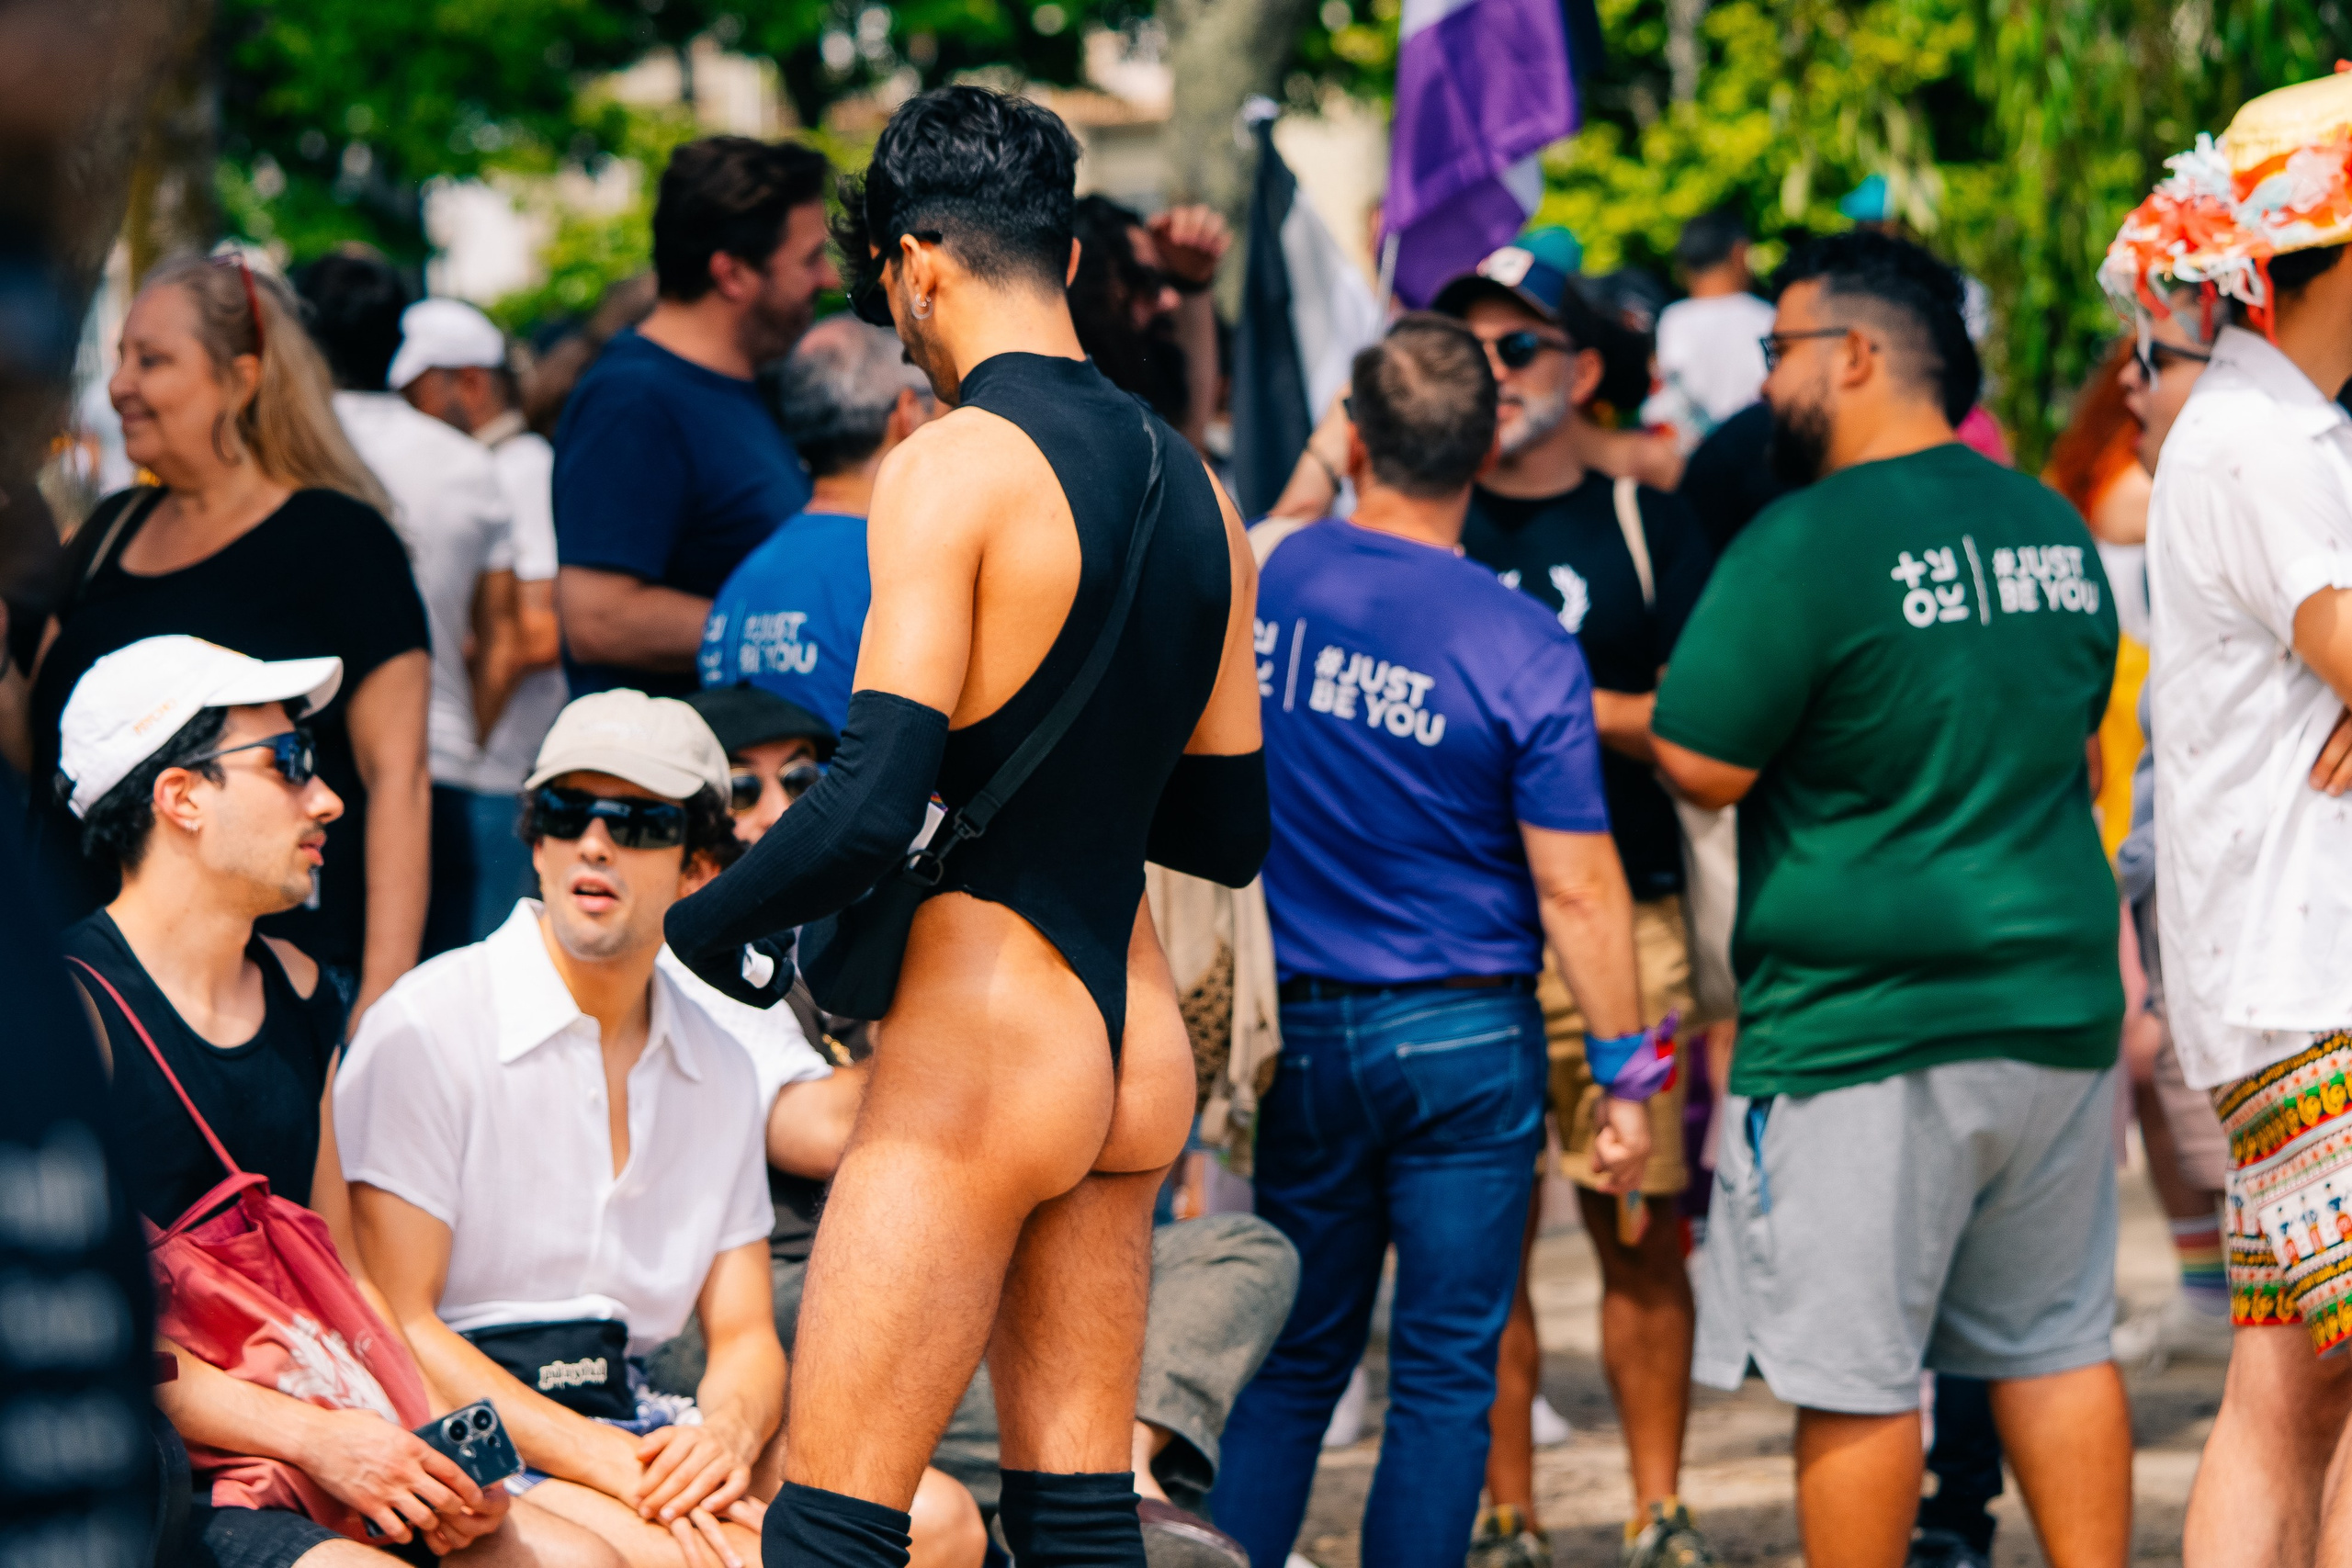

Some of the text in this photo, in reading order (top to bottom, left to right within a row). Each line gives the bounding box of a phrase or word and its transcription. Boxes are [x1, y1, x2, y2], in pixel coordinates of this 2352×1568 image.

[1993, 544, 2084, 578] #JUST
[1997, 576, 2101, 615] BE YOU
[1314, 644, 1436, 709] #JUST
[1308, 678, 1447, 747] BE YOU
